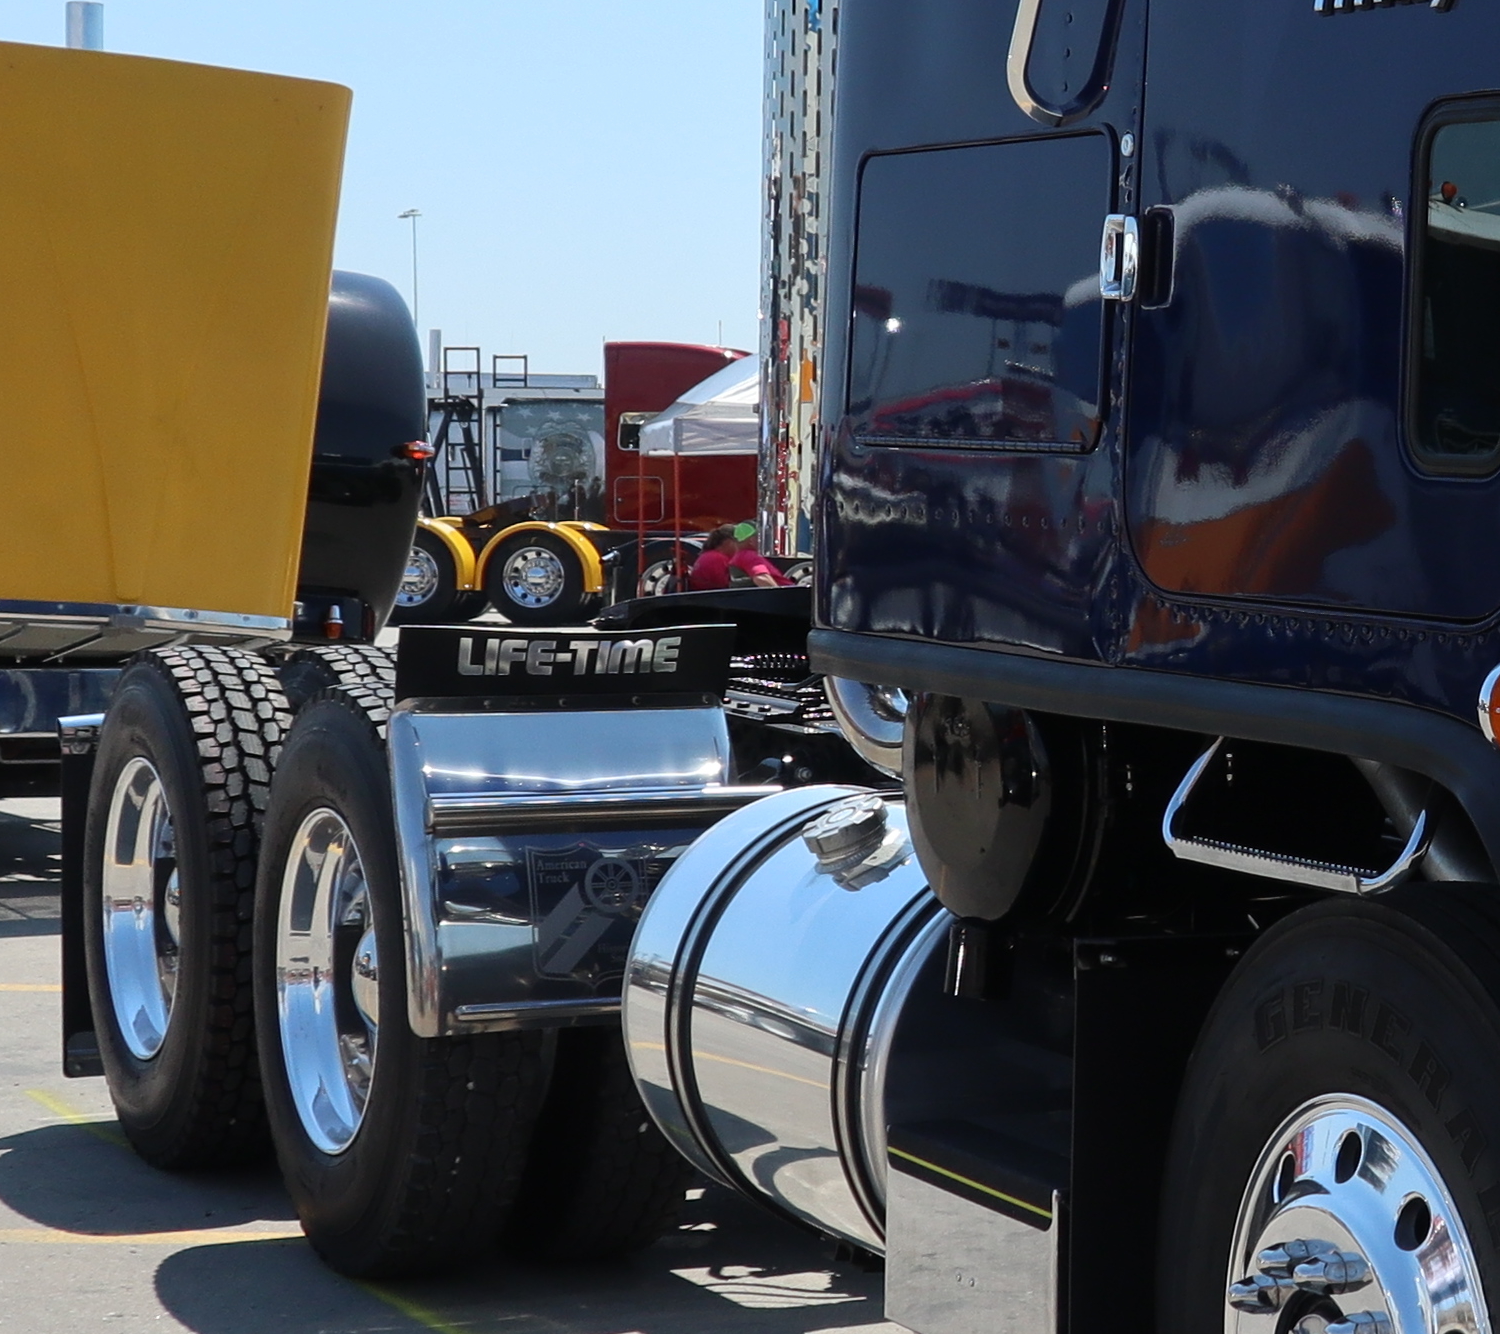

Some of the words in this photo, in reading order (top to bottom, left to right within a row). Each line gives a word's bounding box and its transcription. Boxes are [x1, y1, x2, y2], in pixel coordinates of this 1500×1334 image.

[457, 636, 682, 676] LIFE-TIME
[536, 858, 587, 871] American
[537, 872, 570, 884] Truck
